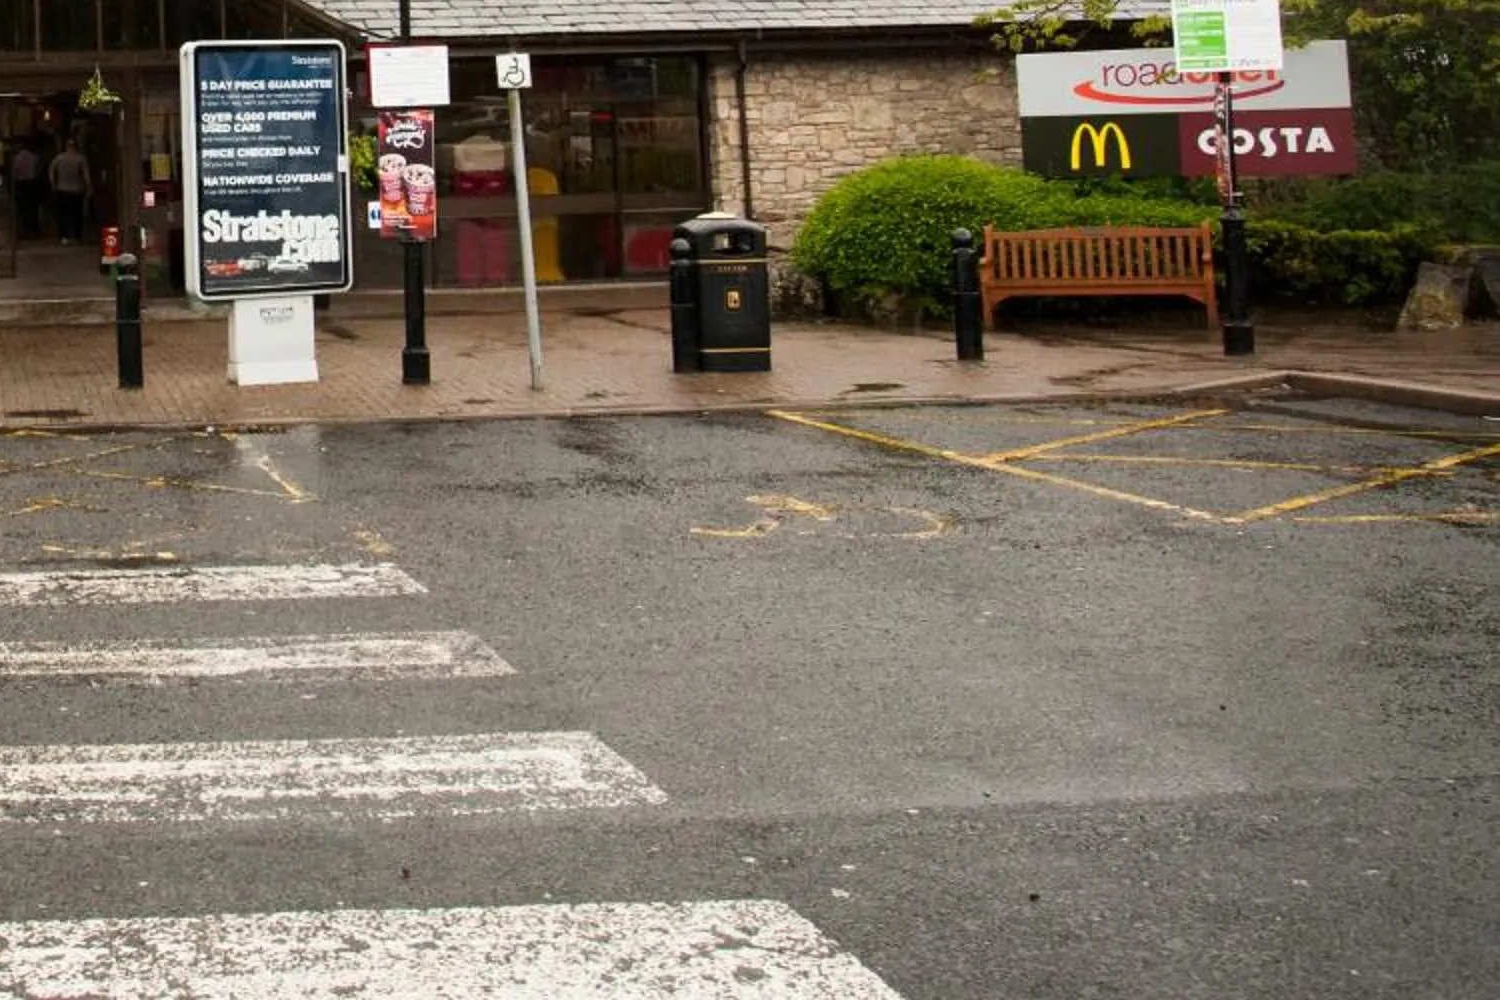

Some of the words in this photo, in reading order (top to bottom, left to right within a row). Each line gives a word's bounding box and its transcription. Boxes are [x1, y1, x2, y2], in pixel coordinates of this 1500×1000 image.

[209, 80, 233, 91] DAY
[234, 80, 266, 90] PRICE
[267, 79, 333, 89] GUARANTEE
[201, 112, 233, 122] OVER
[267, 110, 317, 121] PREMIUM
[233, 123, 262, 133] CARS
[1197, 127, 1336, 157] COSTA
[202, 148, 235, 159] PRICE
[237, 146, 287, 158] CHECKED
[288, 145, 321, 157] DAILY
[203, 174, 274, 187] NATIONWIDE
[275, 172, 335, 185] COVERAGE
[202, 209, 339, 243] Stratstone
[276, 239, 340, 263] .com
